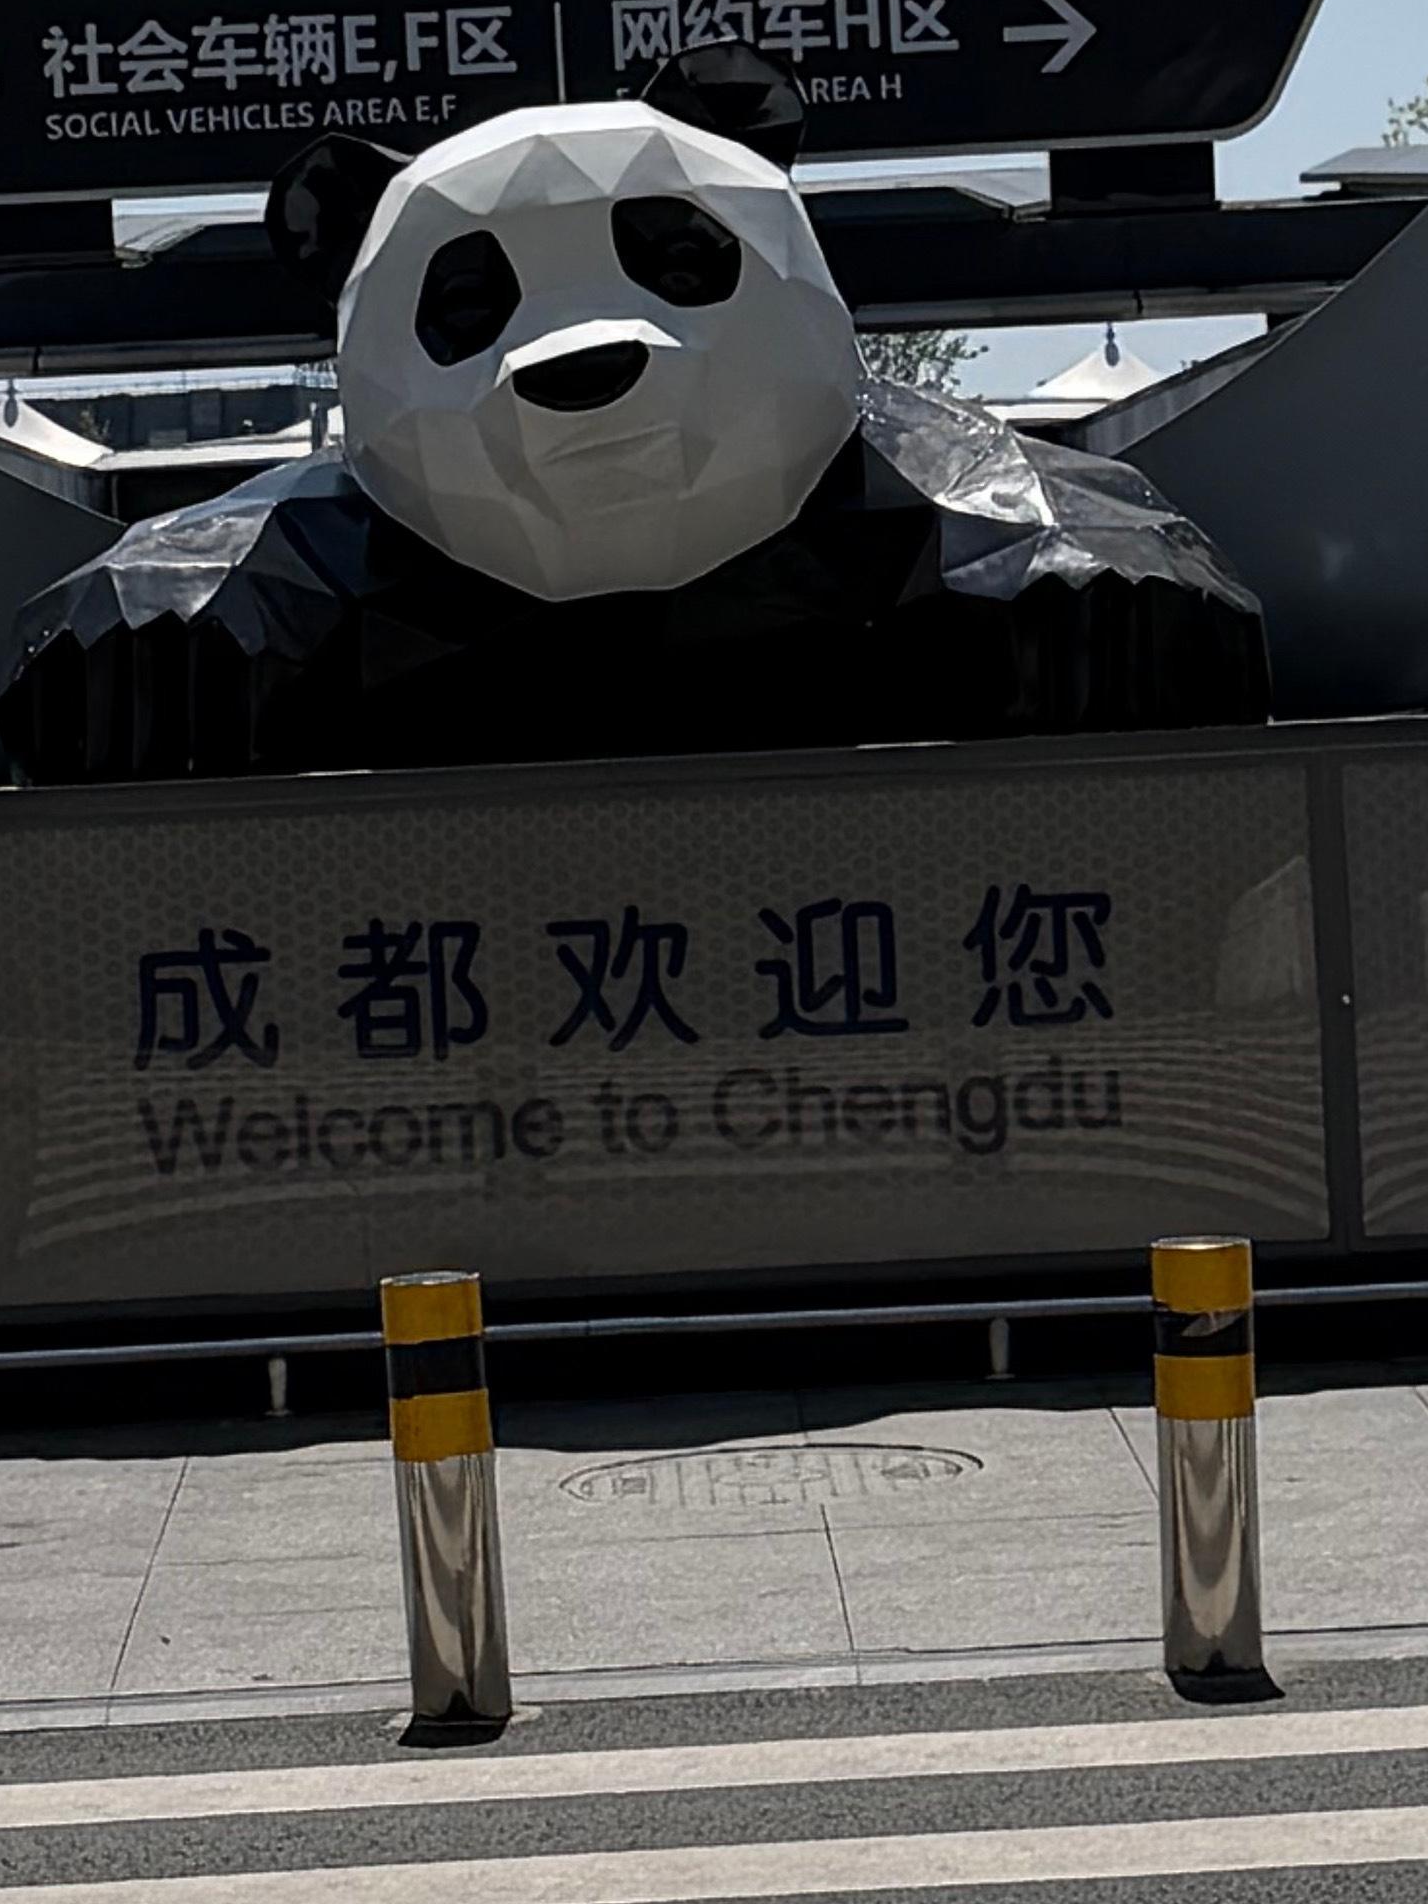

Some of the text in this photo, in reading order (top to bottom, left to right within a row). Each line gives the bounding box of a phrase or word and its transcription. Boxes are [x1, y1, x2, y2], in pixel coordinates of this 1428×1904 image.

[42, 5, 517, 99] 社会车辆E,F区
[880, 72, 903, 100] H
[44, 93, 457, 141] SOCIAL VEHICLES AREA E,F
[132, 882, 1113, 1073] 成都欢迎您
[135, 1054, 1124, 1177] Welcome to Chengdu
